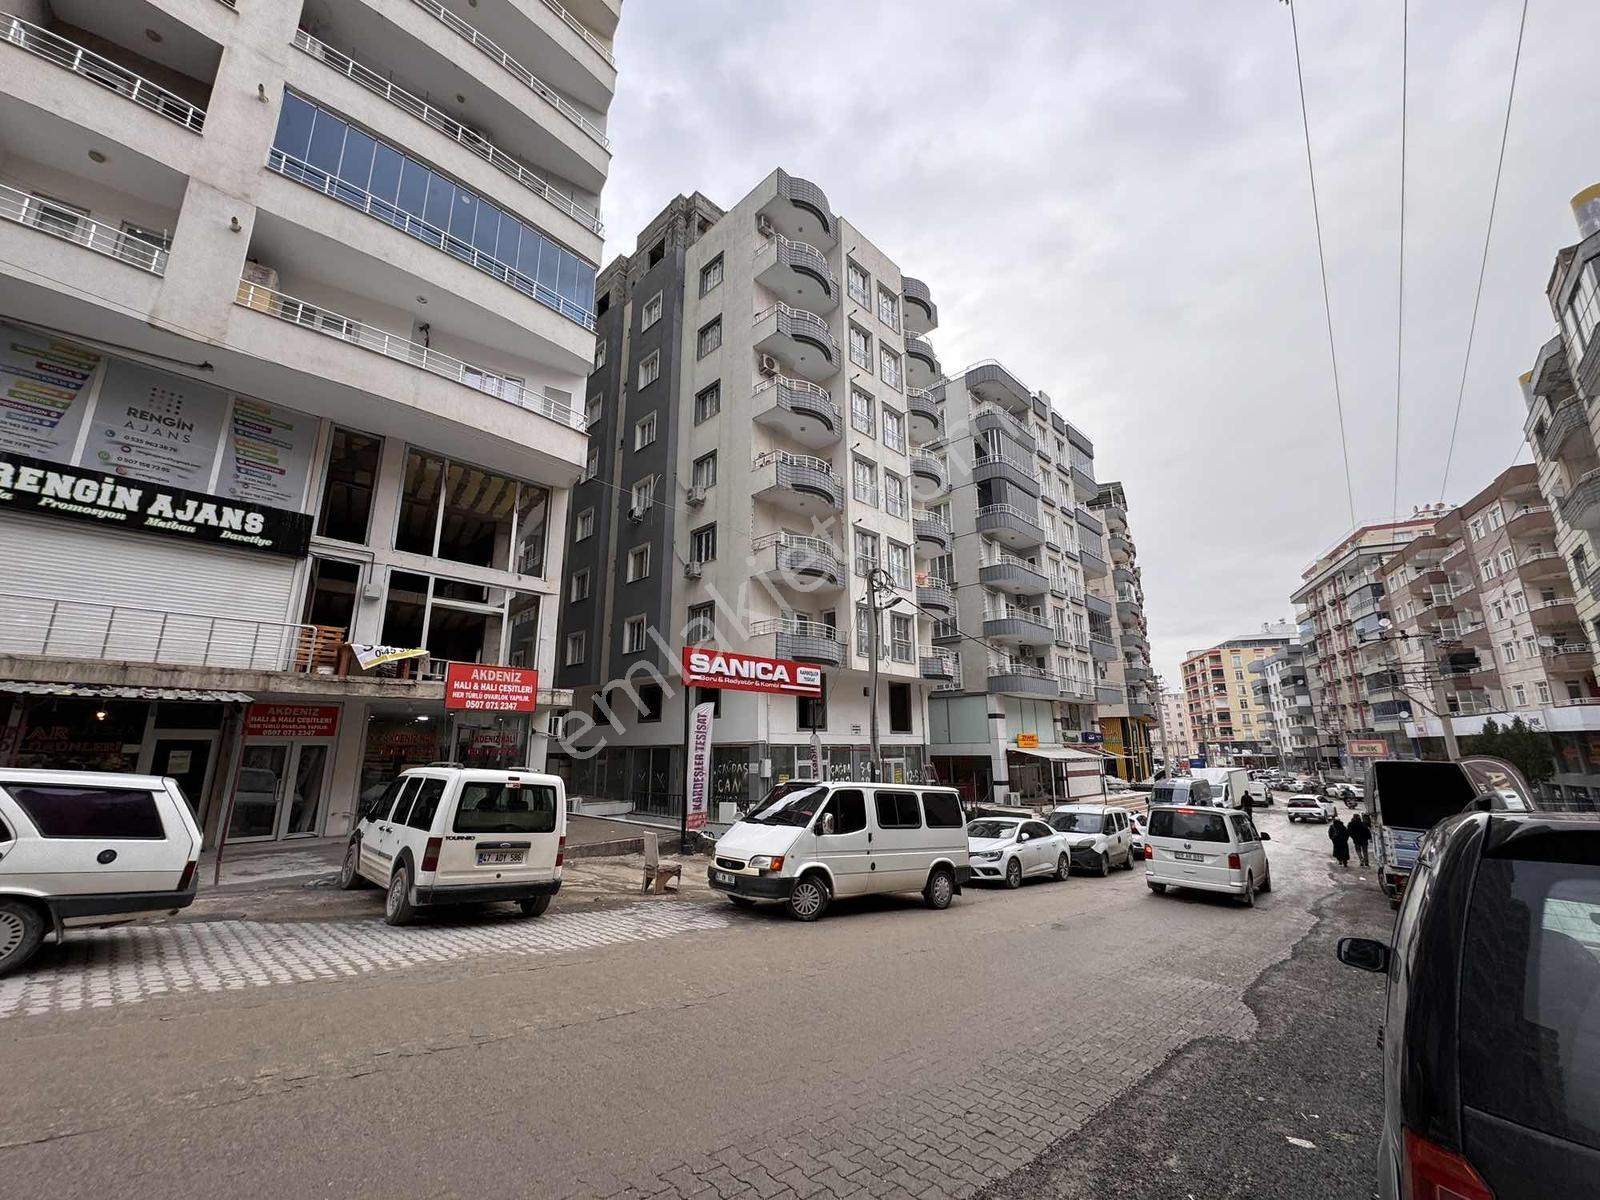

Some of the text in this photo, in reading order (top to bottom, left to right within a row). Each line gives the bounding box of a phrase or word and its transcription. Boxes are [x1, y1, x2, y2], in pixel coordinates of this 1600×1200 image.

[127, 407, 194, 432] RENGİN
[124, 420, 191, 443] AJANS
[0, 462, 265, 534] RENGİN AJANS
[38, 497, 127, 520] Promosyon
[144, 517, 197, 533] Matbaa
[220, 530, 273, 546] Davetiye
[471, 669, 522, 683] AKDENİZ
[689, 653, 790, 682] SANICA
[453, 681, 533, 694] HALI & HALI ÇEŞİTLERİ
[724, 678, 754, 687] Radyatör
[268, 706, 320, 716] AKDENİZ
[466, 700, 517, 711] 0507 071 2347
[695, 713, 708, 751] TESİSAT
[692, 754, 705, 811] KARDEŞLER
